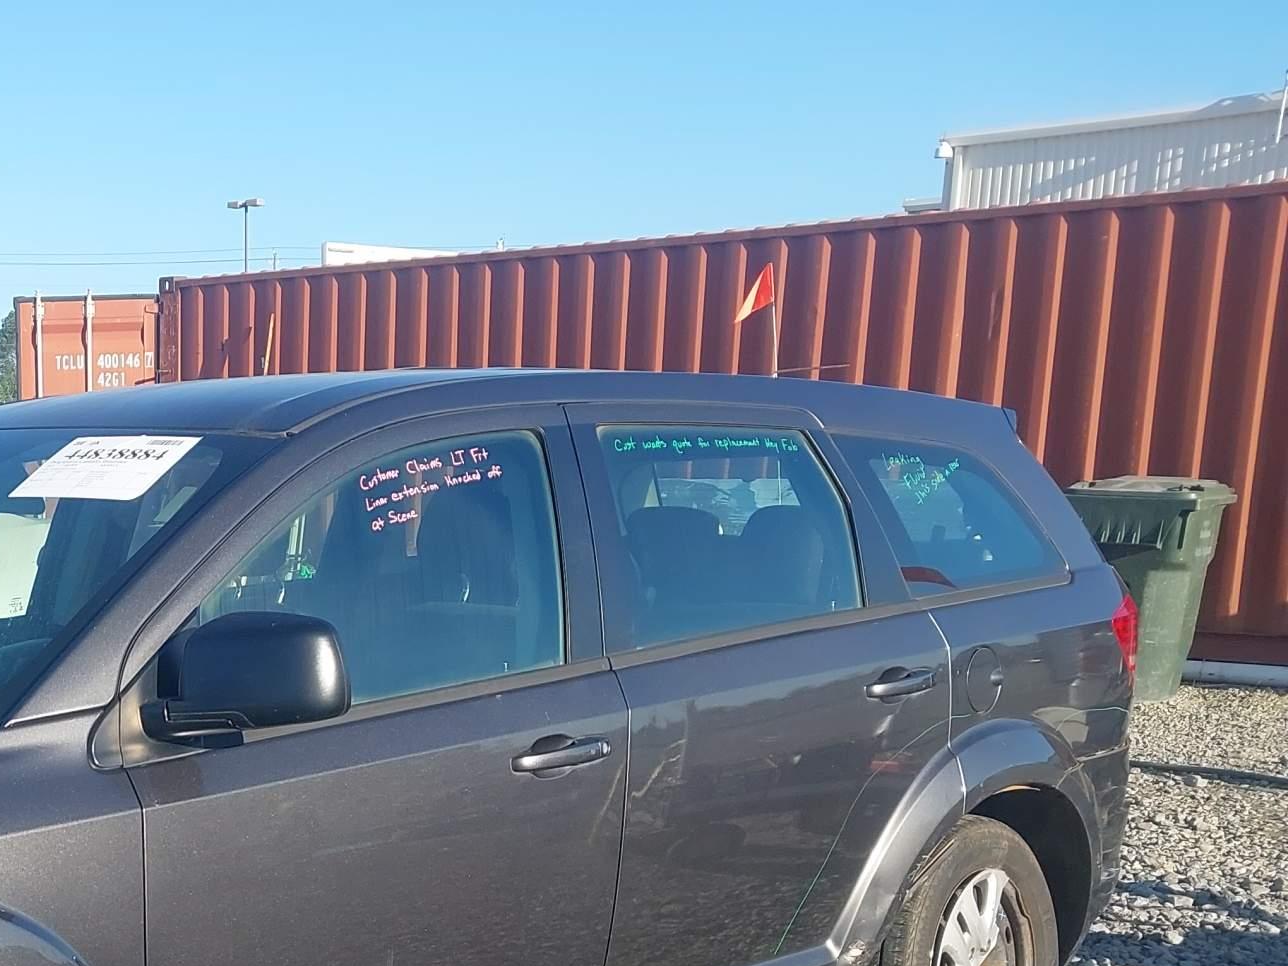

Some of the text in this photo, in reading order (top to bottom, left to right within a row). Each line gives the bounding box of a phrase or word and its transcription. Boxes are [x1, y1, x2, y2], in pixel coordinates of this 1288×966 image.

[55, 352, 154, 370] TCLU 400146 7
[97, 372, 126, 387] 42G1
[64, 448, 169, 461] 44838884
[359, 468, 400, 490] Customer
[406, 458, 442, 474] Claims
[450, 449, 465, 466] LT
[392, 481, 439, 501] extension
[487, 465, 503, 479] off
[372, 517, 385, 531] at
